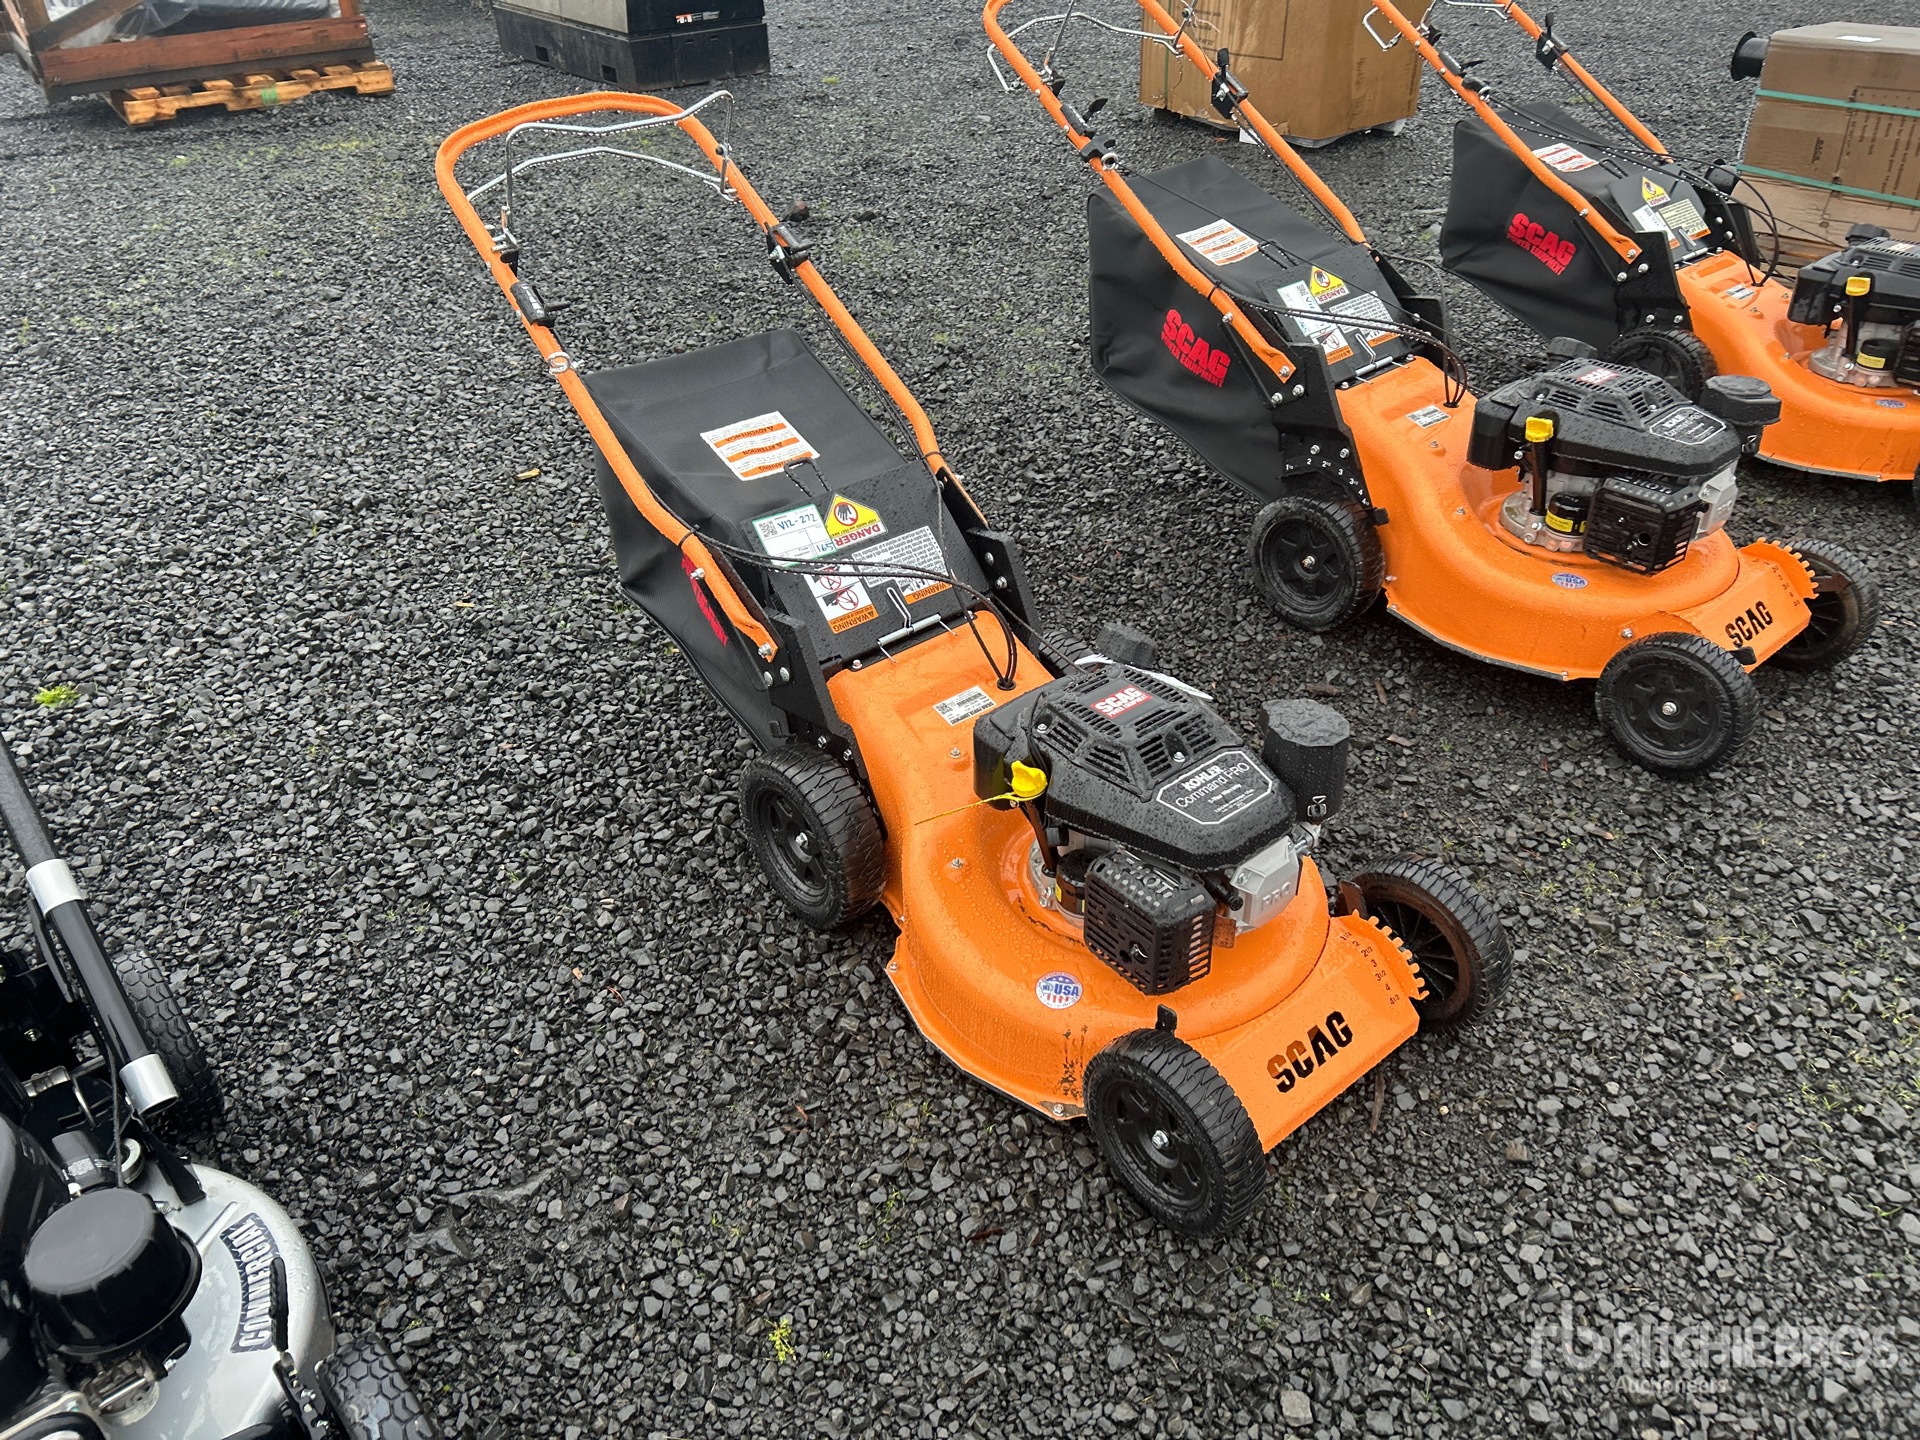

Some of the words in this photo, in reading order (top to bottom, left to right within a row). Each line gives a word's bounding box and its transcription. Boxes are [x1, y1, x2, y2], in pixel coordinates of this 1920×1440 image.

[1507, 211, 1573, 267] SCAG
[1317, 287, 1346, 302] DANGER
[1161, 309, 1232, 379] SCAG
[742, 443, 776, 457] ATTENTION
[834, 523, 881, 548] DANGER
[912, 582, 947, 600] WARNING
[832, 613, 869, 633] WARNING
[1725, 600, 1772, 648] SCAG
[1094, 687, 1143, 712] SCAG
[1176, 776, 1228, 808] Command
[1224, 762, 1250, 779] PRO
[1181, 765, 1223, 791] KOHLER
[1262, 882, 1291, 909] PRO
[1371, 959, 1377, 967] 3
[1054, 984, 1079, 996] USA
[1385, 983, 1390, 991] 4
[1266, 1010, 1353, 1093] SCAG
[229, 1217, 271, 1348] COMMERCIAL
